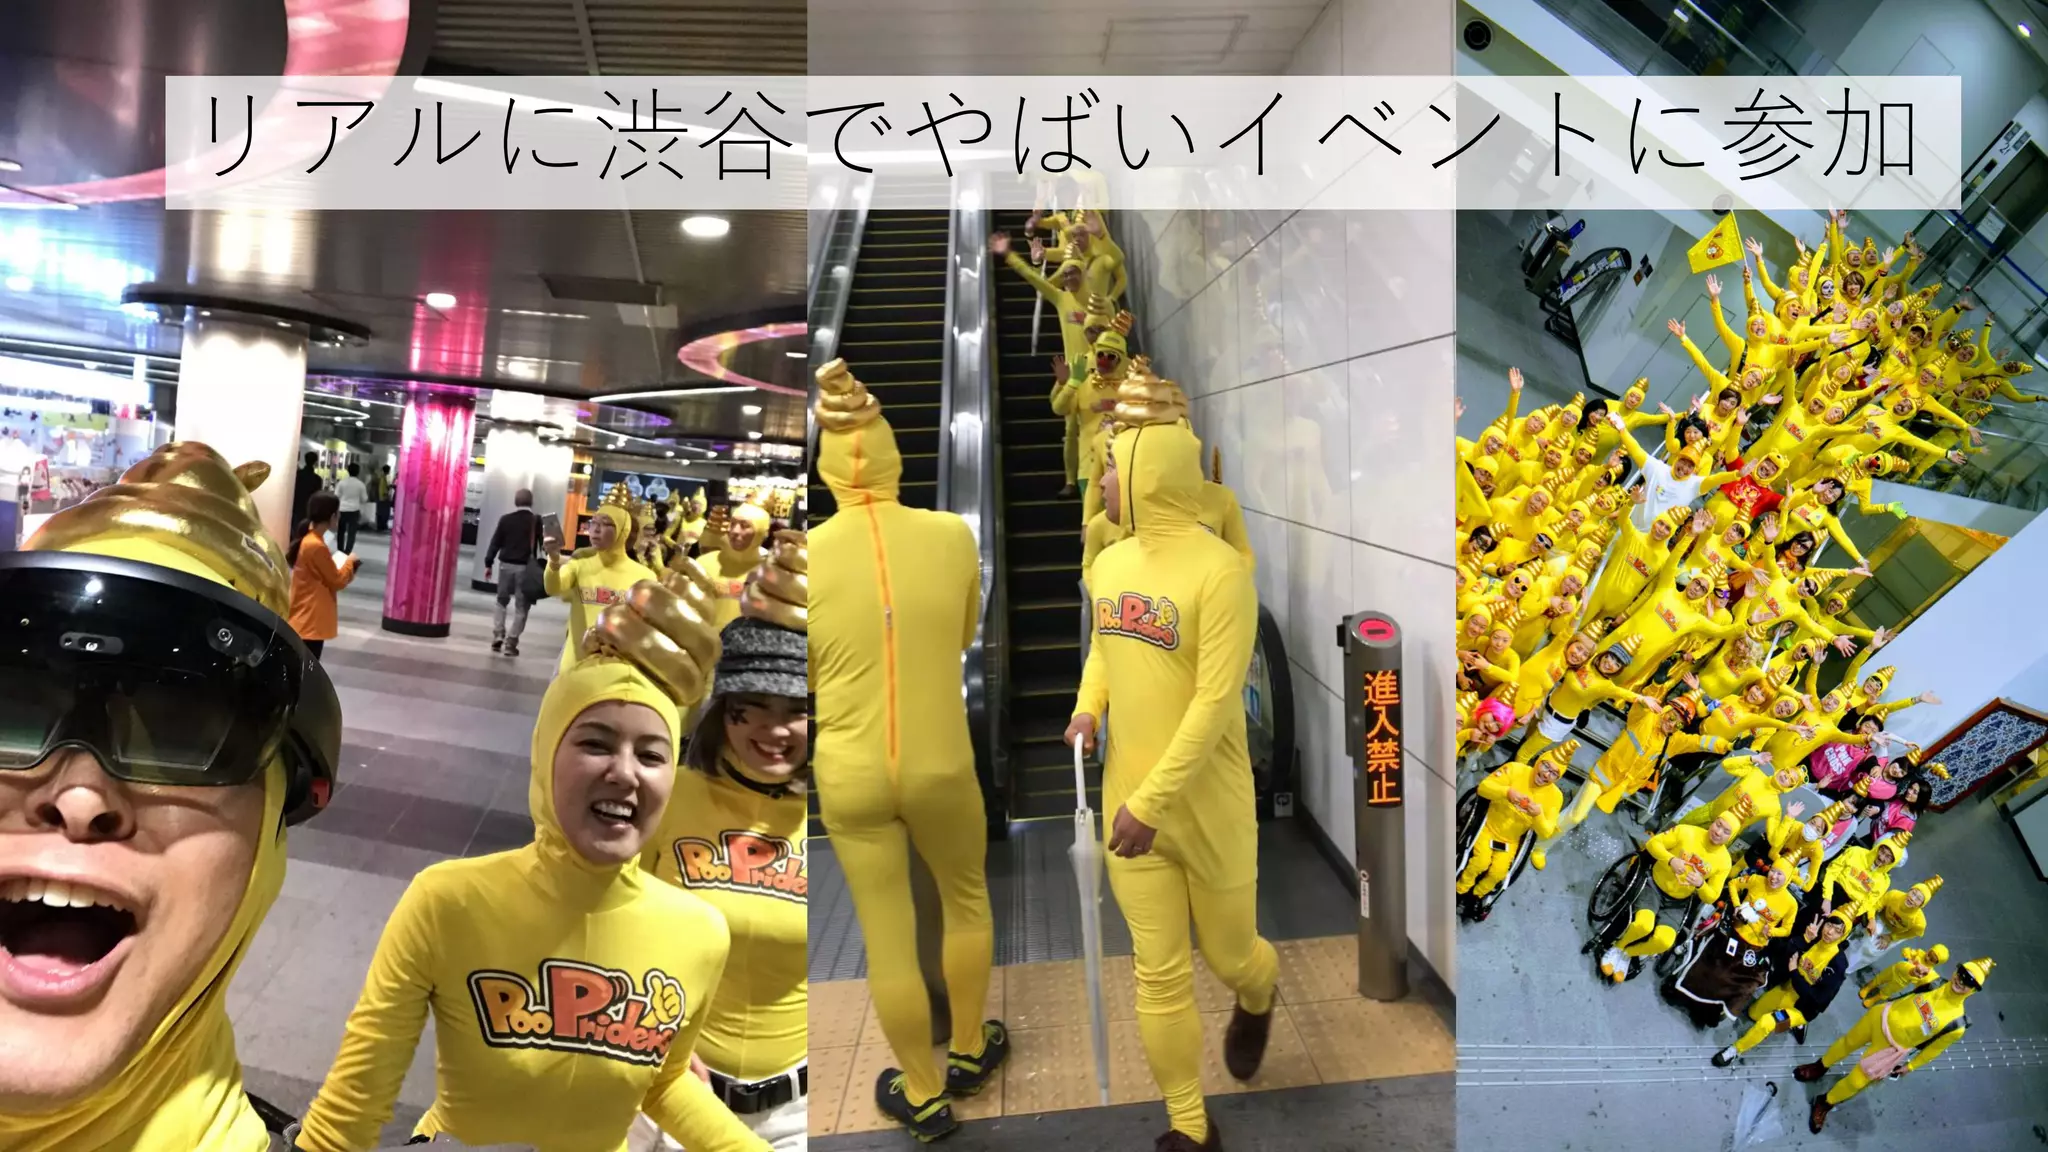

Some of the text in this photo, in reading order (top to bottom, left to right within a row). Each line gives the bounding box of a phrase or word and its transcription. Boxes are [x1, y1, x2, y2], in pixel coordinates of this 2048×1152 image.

[1098, 602, 1122, 629] Poo
[1364, 670, 1402, 804] 進入禁止
[679, 841, 732, 881] Poo
[478, 978, 553, 1035] Poo
